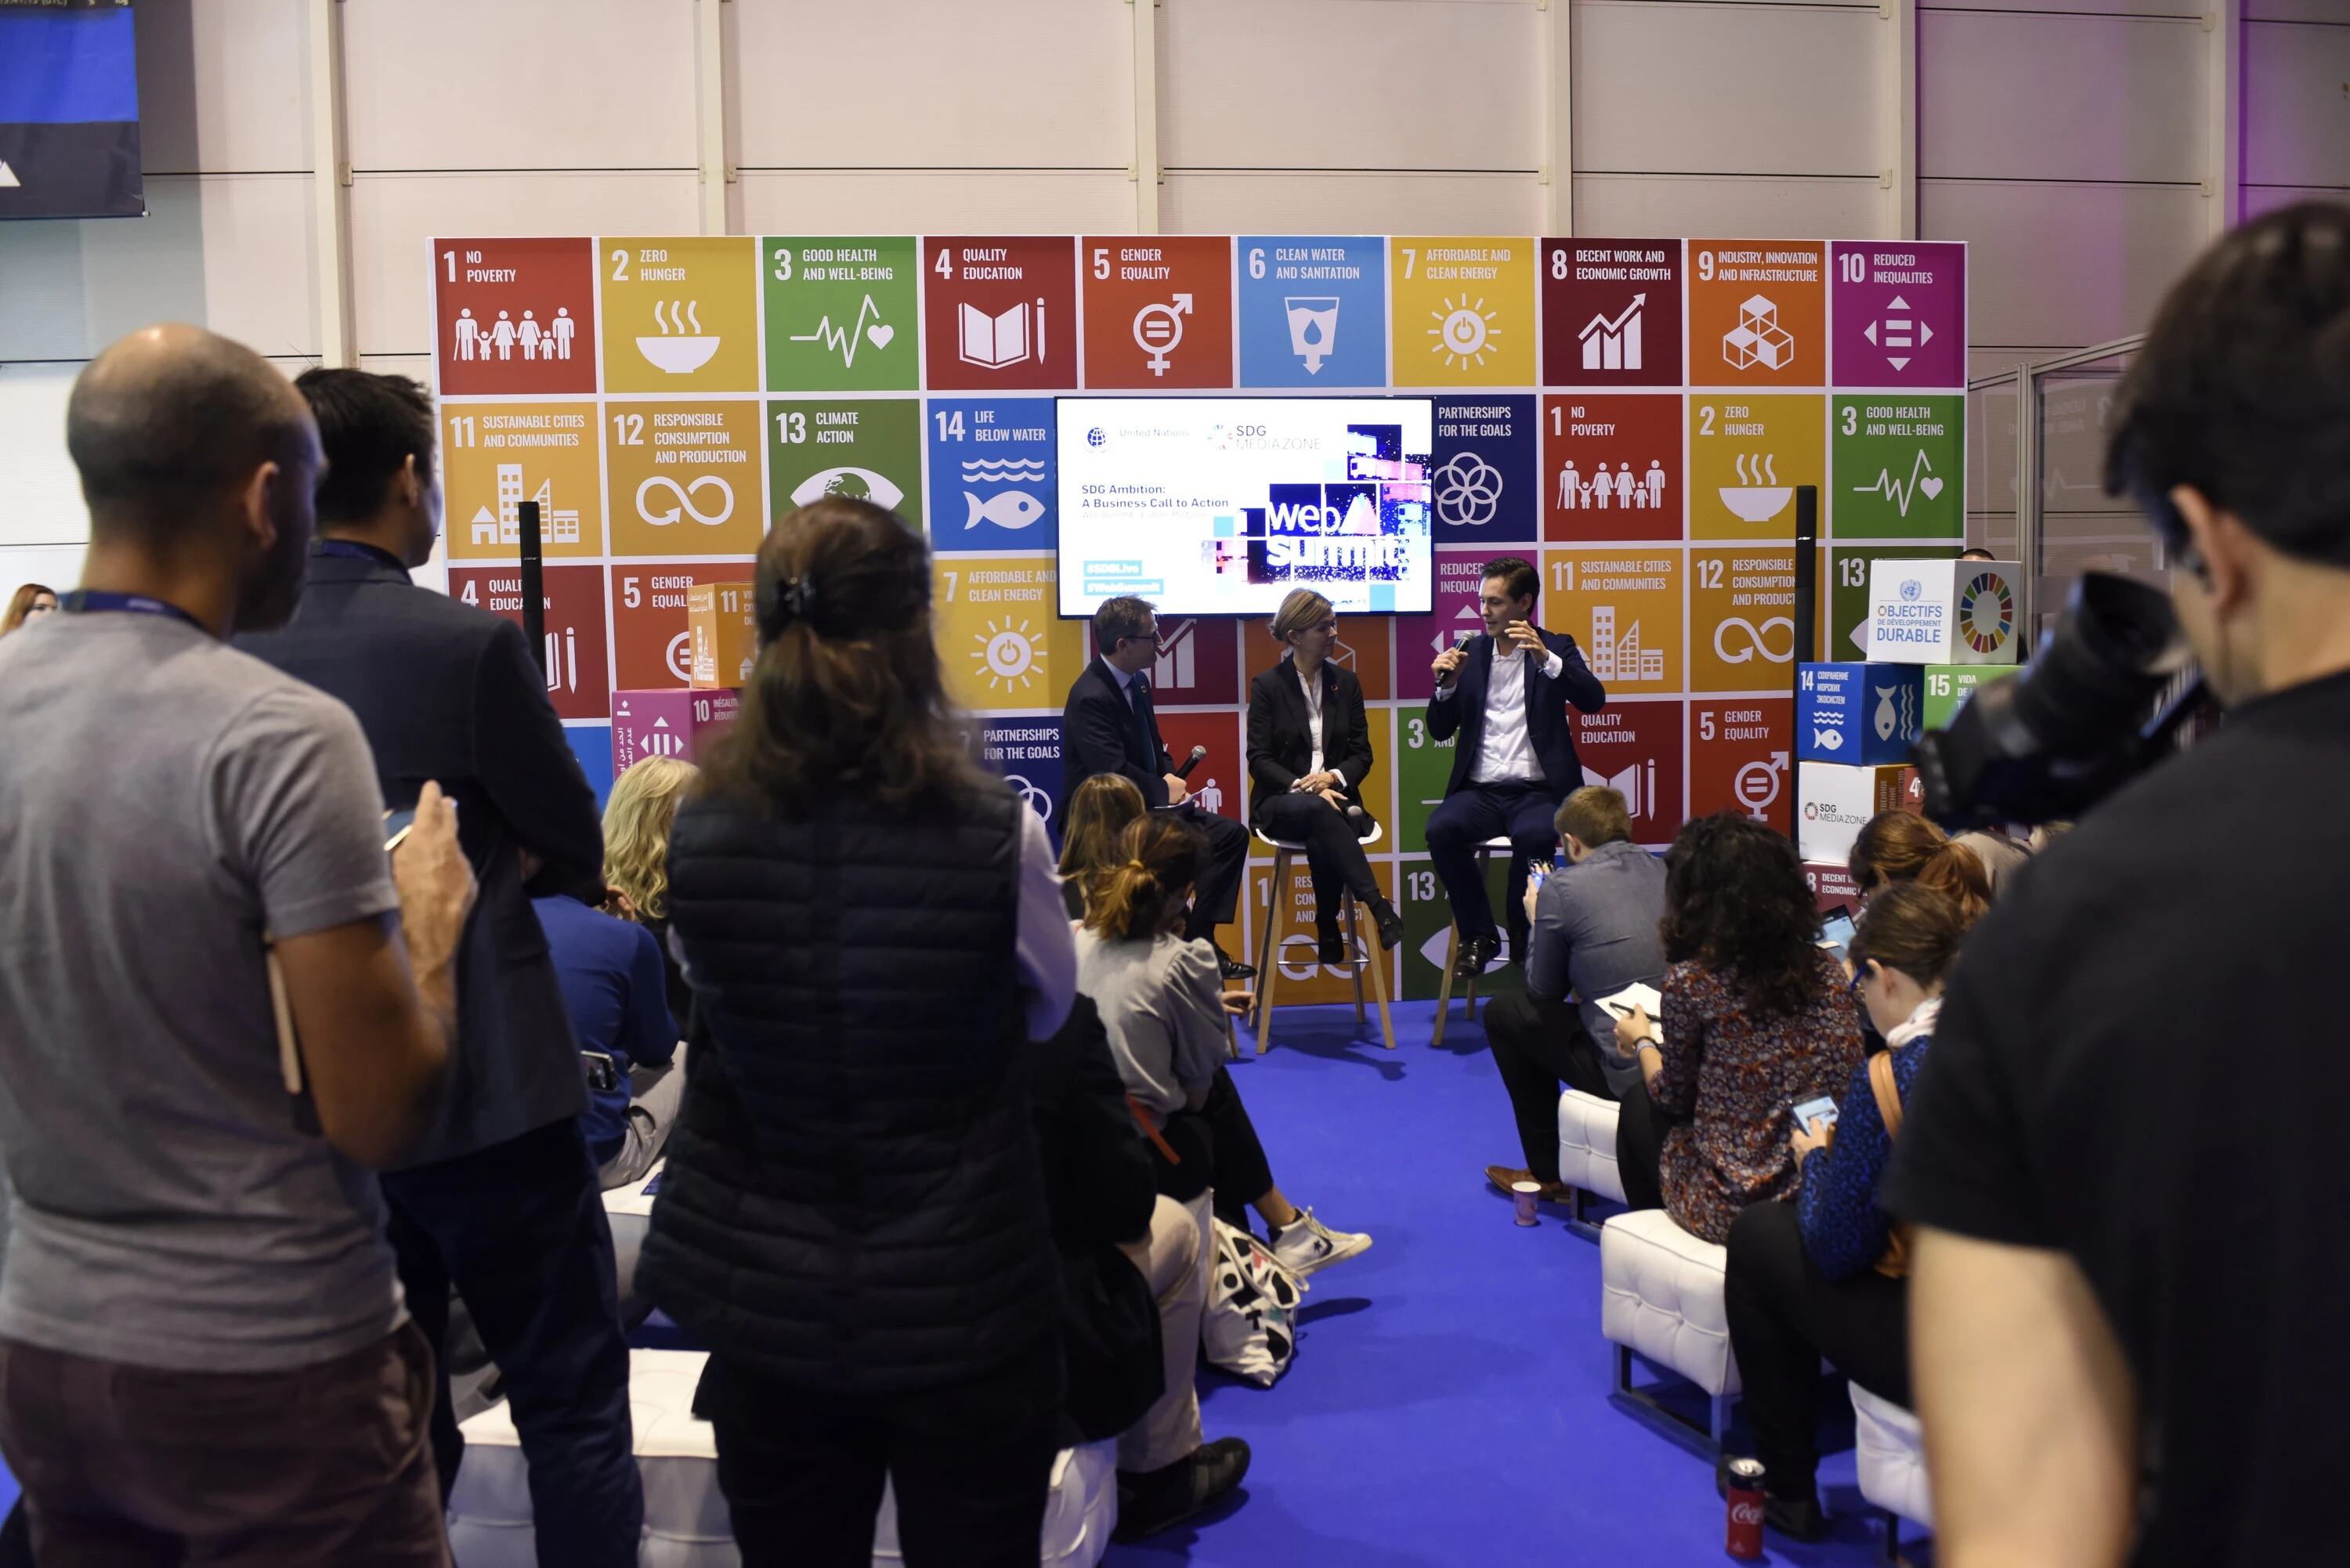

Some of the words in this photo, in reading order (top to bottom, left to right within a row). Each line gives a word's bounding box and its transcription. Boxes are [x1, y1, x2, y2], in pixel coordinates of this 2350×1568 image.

[466, 250, 481, 264] NO
[640, 249, 668, 263] ZERO
[803, 249, 833, 262] GOOD
[837, 249, 877, 262] HEALTH
[963, 249, 1007, 263] QUALITY
[1121, 249, 1161, 261] GENDER
[1276, 248, 1308, 261] CLEAN
[1311, 249, 1345, 261] WATER
[1426, 249, 1487, 261] AFFORDABLE
[1490, 249, 1511, 261] AND
[1576, 249, 1612, 262] DECENT
[1613, 250, 1643, 262] WORK
[1645, 250, 1665, 263] AND
[1718, 251, 1764, 264] INDUSTRY,
[1765, 252, 1818, 264] INNOVATION
[1874, 253, 1916, 266] REDUCED
[444, 251, 456, 282] 1
[611, 249, 629, 281] 2
[774, 249, 792, 281] 3
[935, 249, 953, 279] 4
[1094, 249, 1110, 280] 5
[1249, 248, 1265, 279] 6
[1403, 249, 1416, 279] 7
[1552, 249, 1568, 280] 8
[1698, 251, 1714, 281] 9
[1839, 253, 1865, 283] 10
[466, 269, 516, 282] POVERTY
[640, 268, 686, 281] HUNGER
[803, 267, 825, 280] AND
[828, 267, 893, 280] WELL-BEING
[963, 267, 1023, 280] EDUCATION
[1121, 267, 1170, 281] EQUALITY
[1276, 267, 1298, 279] AND
[1301, 267, 1359, 279] SANITATION
[1427, 267, 1457, 279] CLEAN
[1460, 267, 1497, 279] ENERGY
[1576, 267, 1627, 280] ECONOMIC
[1630, 268, 1670, 280] GROWTH
[1718, 269, 1738, 281] AND
[1739, 269, 1818, 282] INFRASTRUCTURE
[1874, 271, 1933, 285] INEQUALITIES
[816, 412, 859, 425] CLIMATE
[975, 411, 994, 423] LIFE
[1439, 406, 1511, 419] PARTNERSHIPS
[1571, 406, 1585, 419] NO
[1725, 406, 1749, 418] ZERO
[1866, 407, 1893, 419] GOOD
[1896, 407, 1931, 419] HEALTH
[483, 415, 551, 429] SUSTAINABLE
[553, 415, 585, 428] CITIES
[654, 413, 723, 426] RESPONSIBLE
[935, 411, 965, 441] 14
[1551, 406, 1562, 436] 1
[1699, 406, 1715, 435] 2
[1842, 406, 1857, 436] 3
[450, 416, 475, 448] 11
[614, 414, 644, 445] 12
[776, 412, 806, 444] 13
[976, 429, 1010, 441] BELOW
[1012, 428, 1046, 441] WATER
[1236, 425, 1266, 437] SDG
[1439, 425, 1457, 437] FOR
[1460, 424, 1478, 437] THE
[1480, 424, 1511, 437] GOALS
[1571, 424, 1615, 436] POVERTY
[1725, 423, 1764, 435] HUNGER
[1866, 424, 1886, 435] AND
[1888, 424, 1944, 436] WELL-BEING
[484, 434, 506, 448] AND
[507, 434, 579, 447] COMMUNITIES
[654, 432, 730, 445] CONSUMPTION
[817, 430, 853, 443] ACTION
[655, 451, 677, 463] AND
[680, 450, 746, 463] PRODUCTION
[1081, 485, 1106, 494] SDG
[1110, 485, 1165, 494] Ambition:
[1082, 499, 1090, 508] A
[1094, 499, 1146, 508] Business
[1150, 499, 1172, 507] Call
[1191, 499, 1228, 507] Action
[1267, 501, 1342, 534] web
[1581, 560, 1641, 573] SUSTAINABLE
[1644, 560, 1671, 572] CITIES
[1732, 559, 1793, 571] RESPONSIBLE
[1839, 557, 1865, 587] 13
[968, 571, 1032, 583] AFFORDABLE
[1036, 570, 1057, 582] AND
[1552, 561, 1573, 591] 11
[1697, 560, 1724, 589] 12
[489, 580, 522, 594] QUALI
[651, 576, 693, 589] GENDER
[943, 571, 958, 602] 7
[1441, 581, 1480, 594] INEQUAL
[1581, 578, 1601, 590] AND
[1602, 578, 1666, 590] COMMUNITIES
[461, 580, 479, 607] 4
[624, 577, 641, 608] 5
[969, 589, 1001, 602] CLEAN
[1004, 589, 1043, 601] ENERGY
[1733, 594, 1752, 605] AND
[1754, 593, 1795, 605] PRODUCT
[653, 595, 689, 609] EQUAL
[720, 591, 738, 612] 11
[1877, 605, 1942, 618] OBJECTIFS
[1887, 619, 1942, 627] DÉVELOPPEMENT
[1877, 627, 1941, 643] DURABLE
[1801, 670, 1813, 691] 14
[1928, 674, 1950, 696] 15
[1958, 674, 1976, 684] VIDA
[693, 699, 710, 722] 10
[1725, 710, 1761, 723] GENDER
[1581, 714, 1621, 728] QUALITY
[1700, 712, 1715, 741] 5
[984, 728, 1059, 742] PARTNERSHIPS
[1408, 718, 1424, 749] 3
[1581, 730, 1635, 744] EDUCATION
[1725, 727, 1769, 741] EQUALITY
[984, 747, 1003, 760] FOR
[1006, 746, 1025, 759] THE
[1027, 746, 1060, 758] GOALS
[1909, 776, 1919, 797] 4
[1820, 804, 1837, 813] SDG
[1806, 872, 1817, 892] 8
[1821, 873, 1846, 883] DECENT
[1408, 872, 1436, 901] 13
[1821, 885, 1857, 896] ECONOMIC
[1295, 911, 1315, 923] AND
